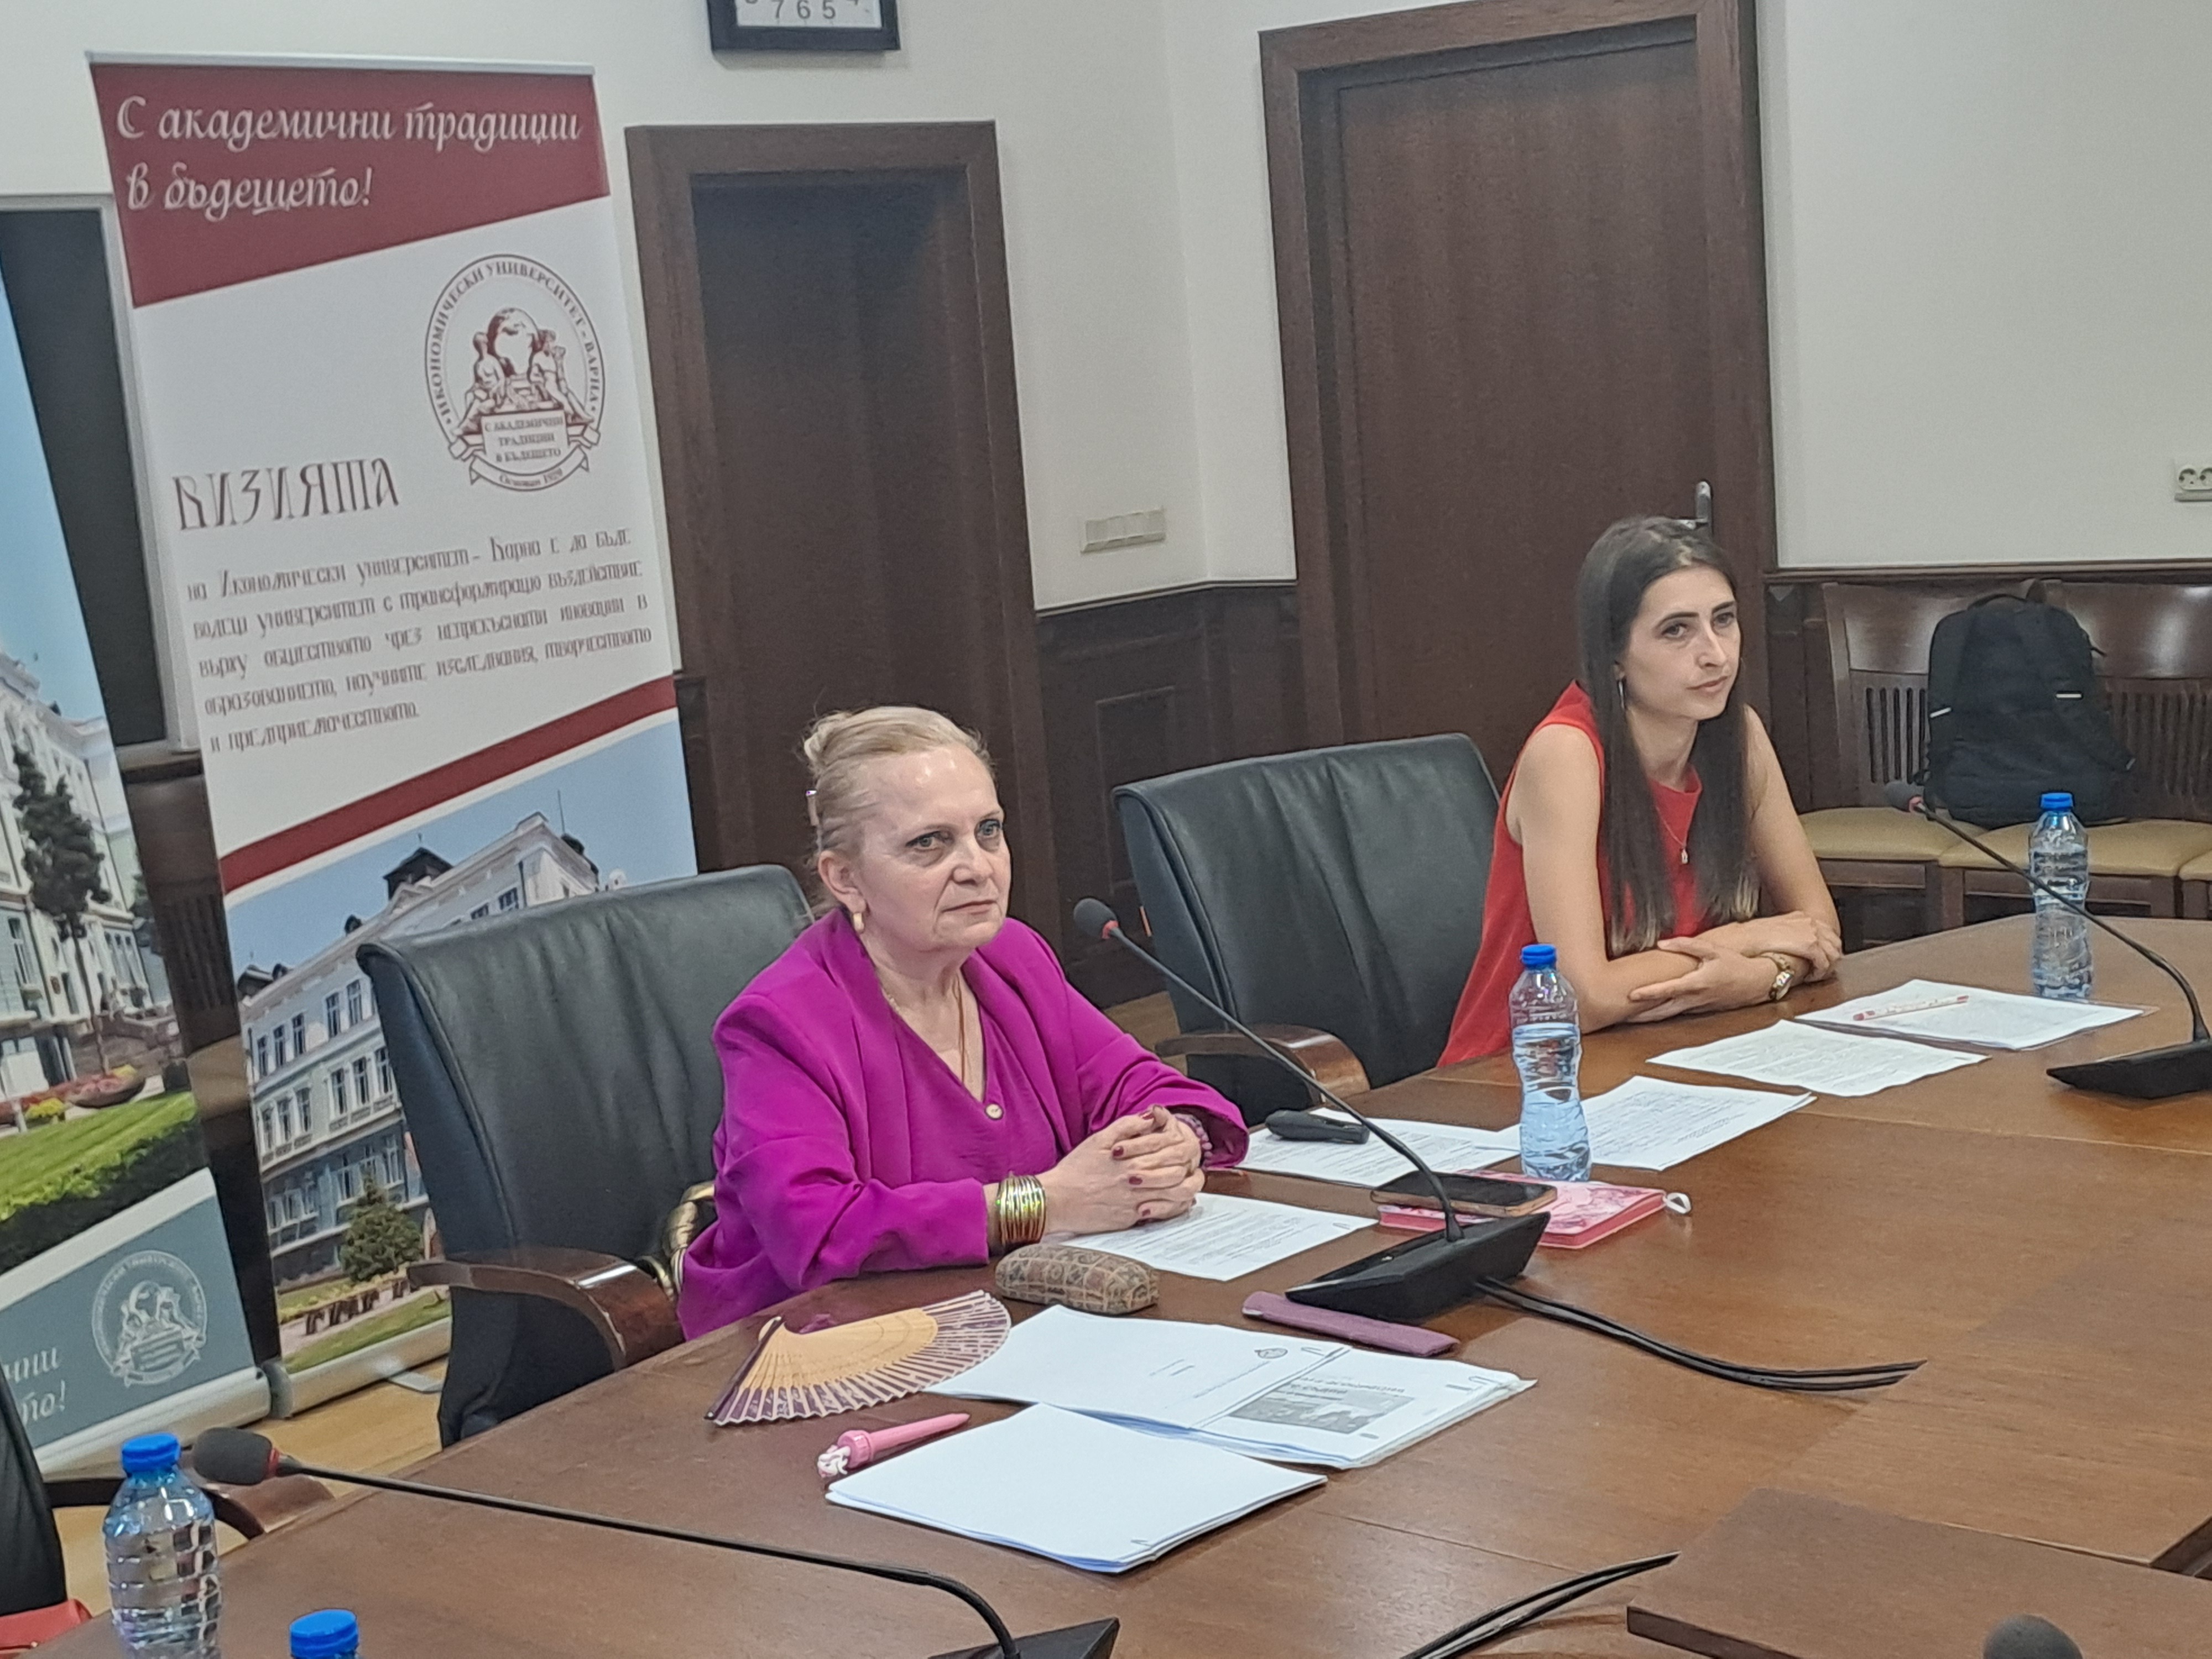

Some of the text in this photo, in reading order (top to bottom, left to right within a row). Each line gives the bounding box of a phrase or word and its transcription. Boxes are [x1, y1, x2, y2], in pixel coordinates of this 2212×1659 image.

[117, 96, 581, 153] С академични традиции
[127, 161, 373, 222] в бъдещето!
[430, 270, 484, 416] ИКОНОМИЧЕСКИ
[486, 261, 585, 326] УНИВЕРСИТЕТ
[585, 341, 601, 405] ВАРНА
[172, 457, 399, 530] ВИЗИЯТА
[187, 583, 207, 601] на
[357, 549, 469, 586] университет
[194, 615, 247, 640] водещ
[257, 597, 375, 638] университет
[400, 575, 541, 612] трансформиращо
[199, 653, 248, 680] върху
[264, 635, 372, 668] обществото
[385, 627, 423, 651] чрез
[437, 608, 548, 641] непрекъснати
[560, 597, 625, 622] иновации
[545, 627, 652, 659] творчеството
